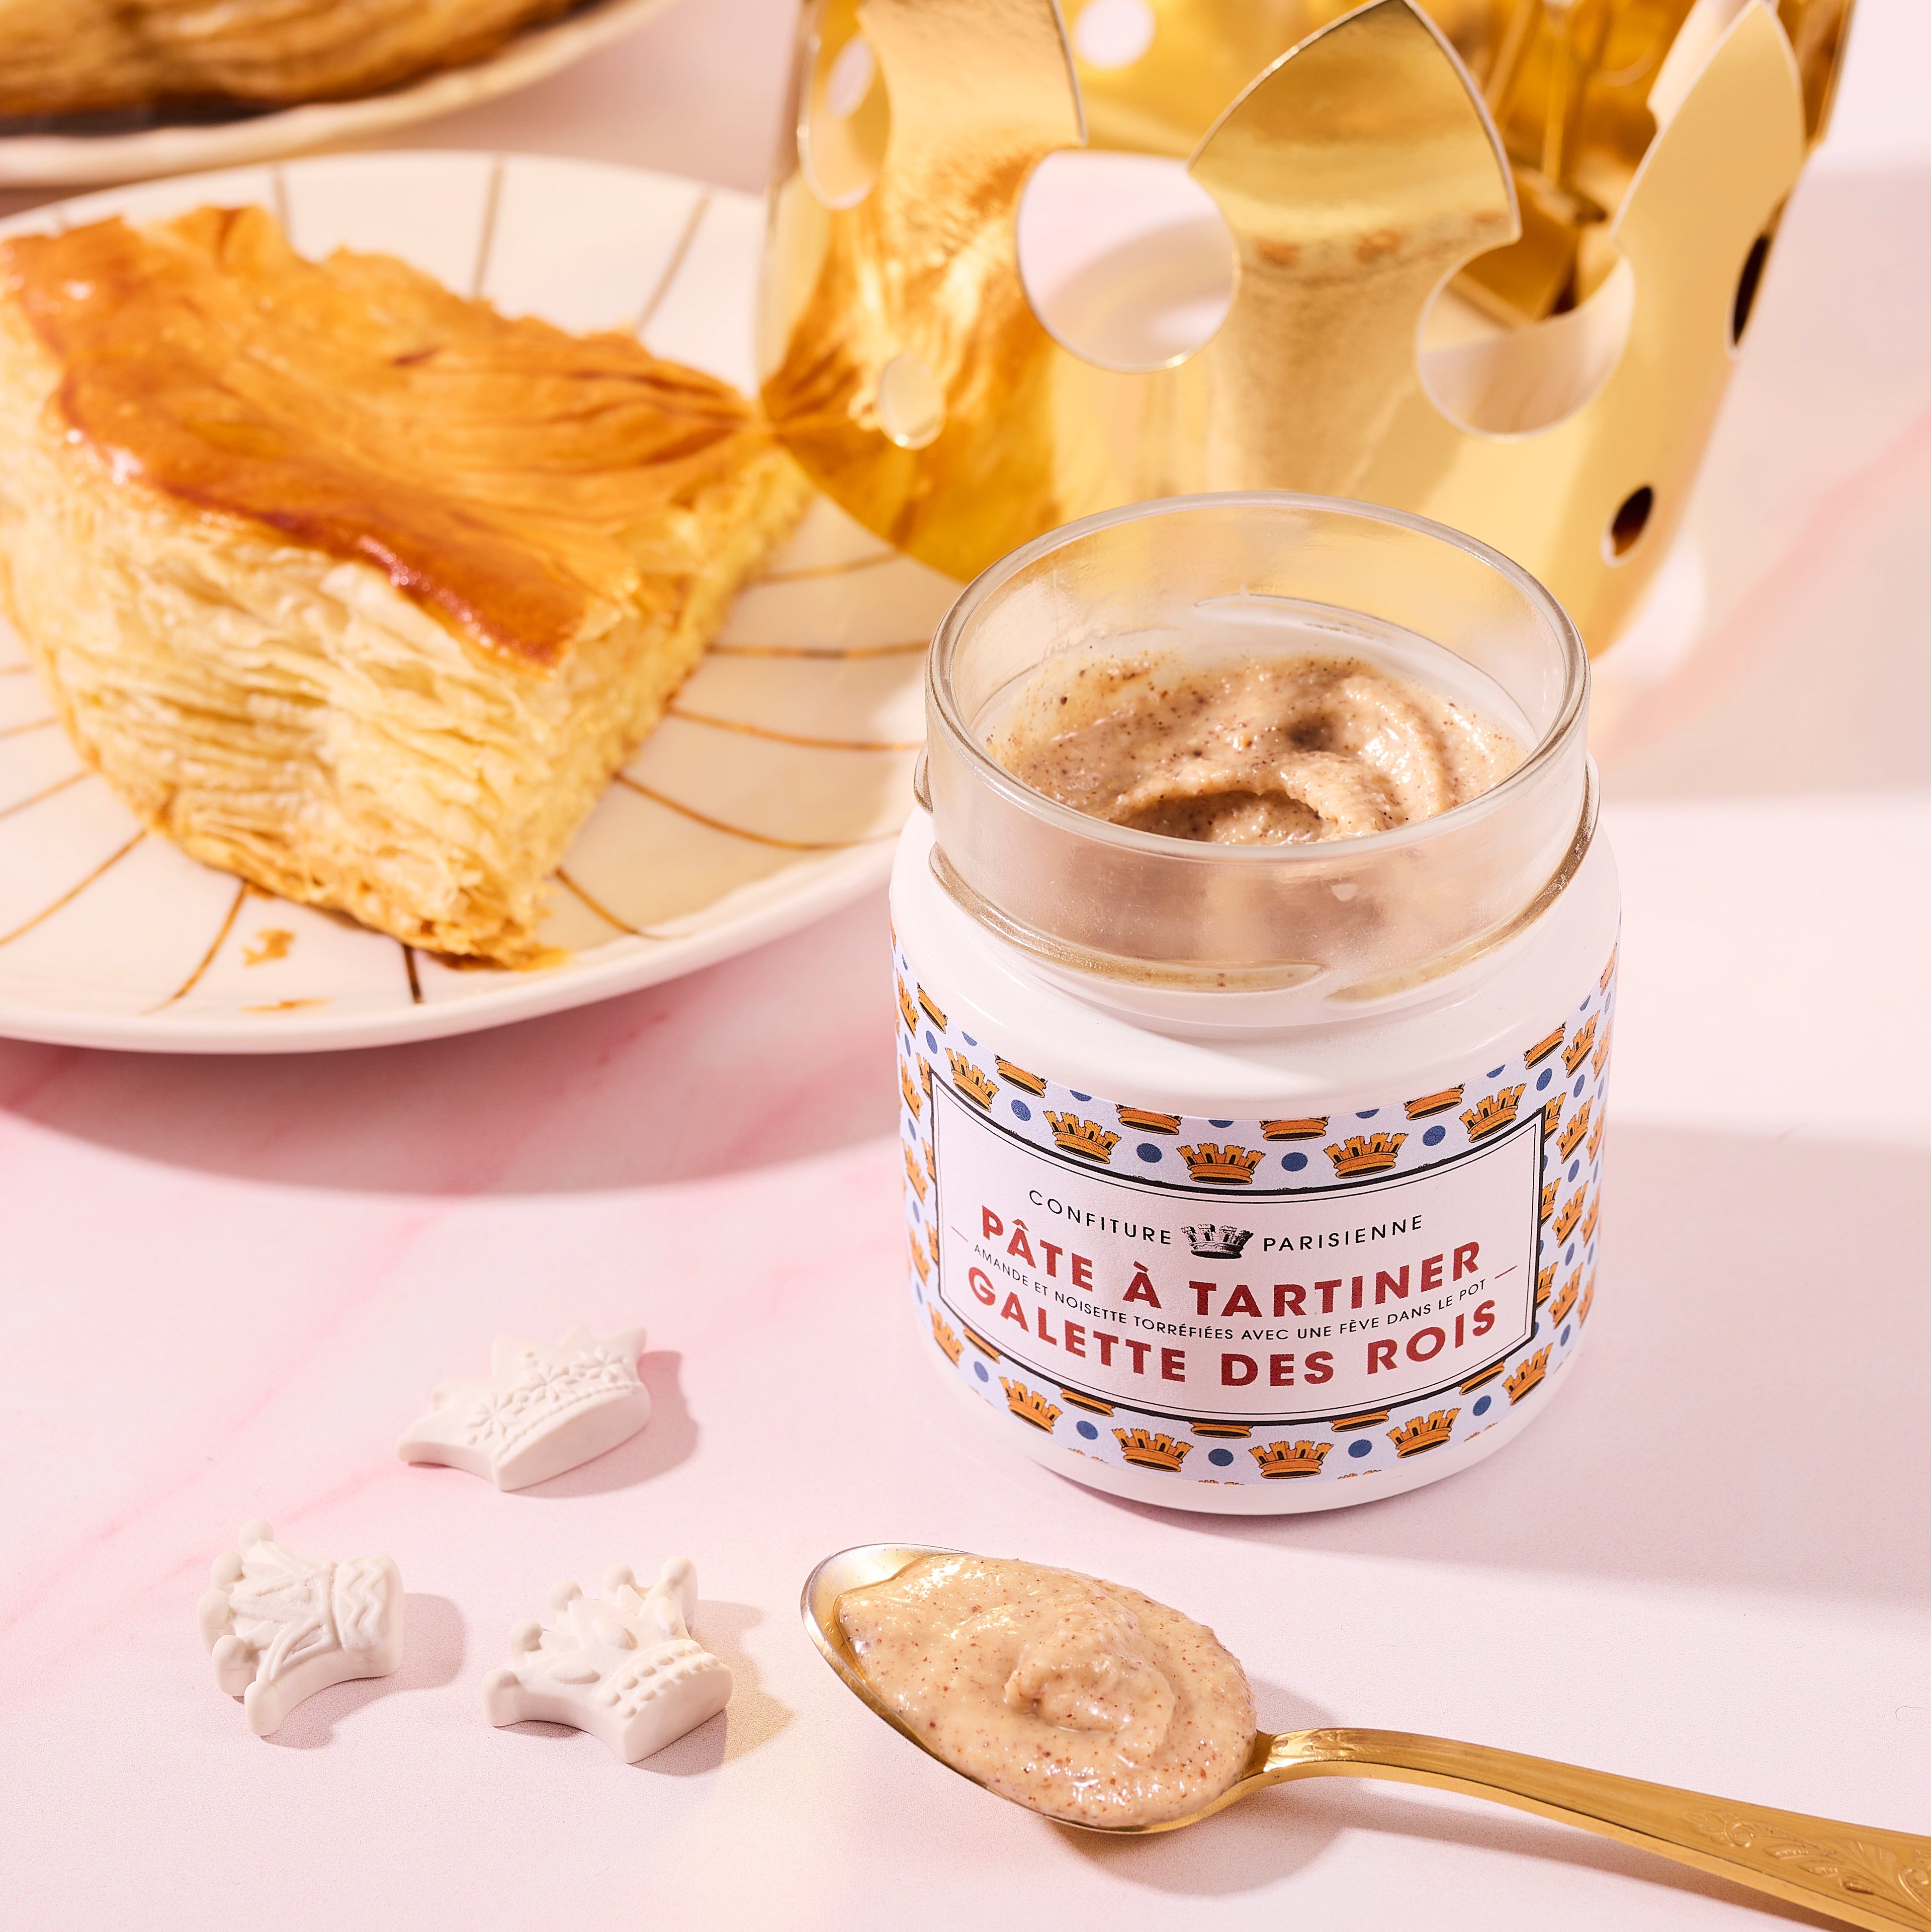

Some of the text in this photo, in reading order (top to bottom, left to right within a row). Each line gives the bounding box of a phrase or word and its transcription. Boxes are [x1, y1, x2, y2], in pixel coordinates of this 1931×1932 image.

[982, 1205, 1479, 1317] PÂTE À TARTINER
[1029, 1190, 1423, 1252] CONFITURE PARISIENNE
[968, 1266, 1496, 1387] GALETTE DES ROIS
[974, 1244, 1486, 1340] AMANDE ET NOISETTE TORRÉFIÉES AVEC UNE FÈVE DANS LE POT
